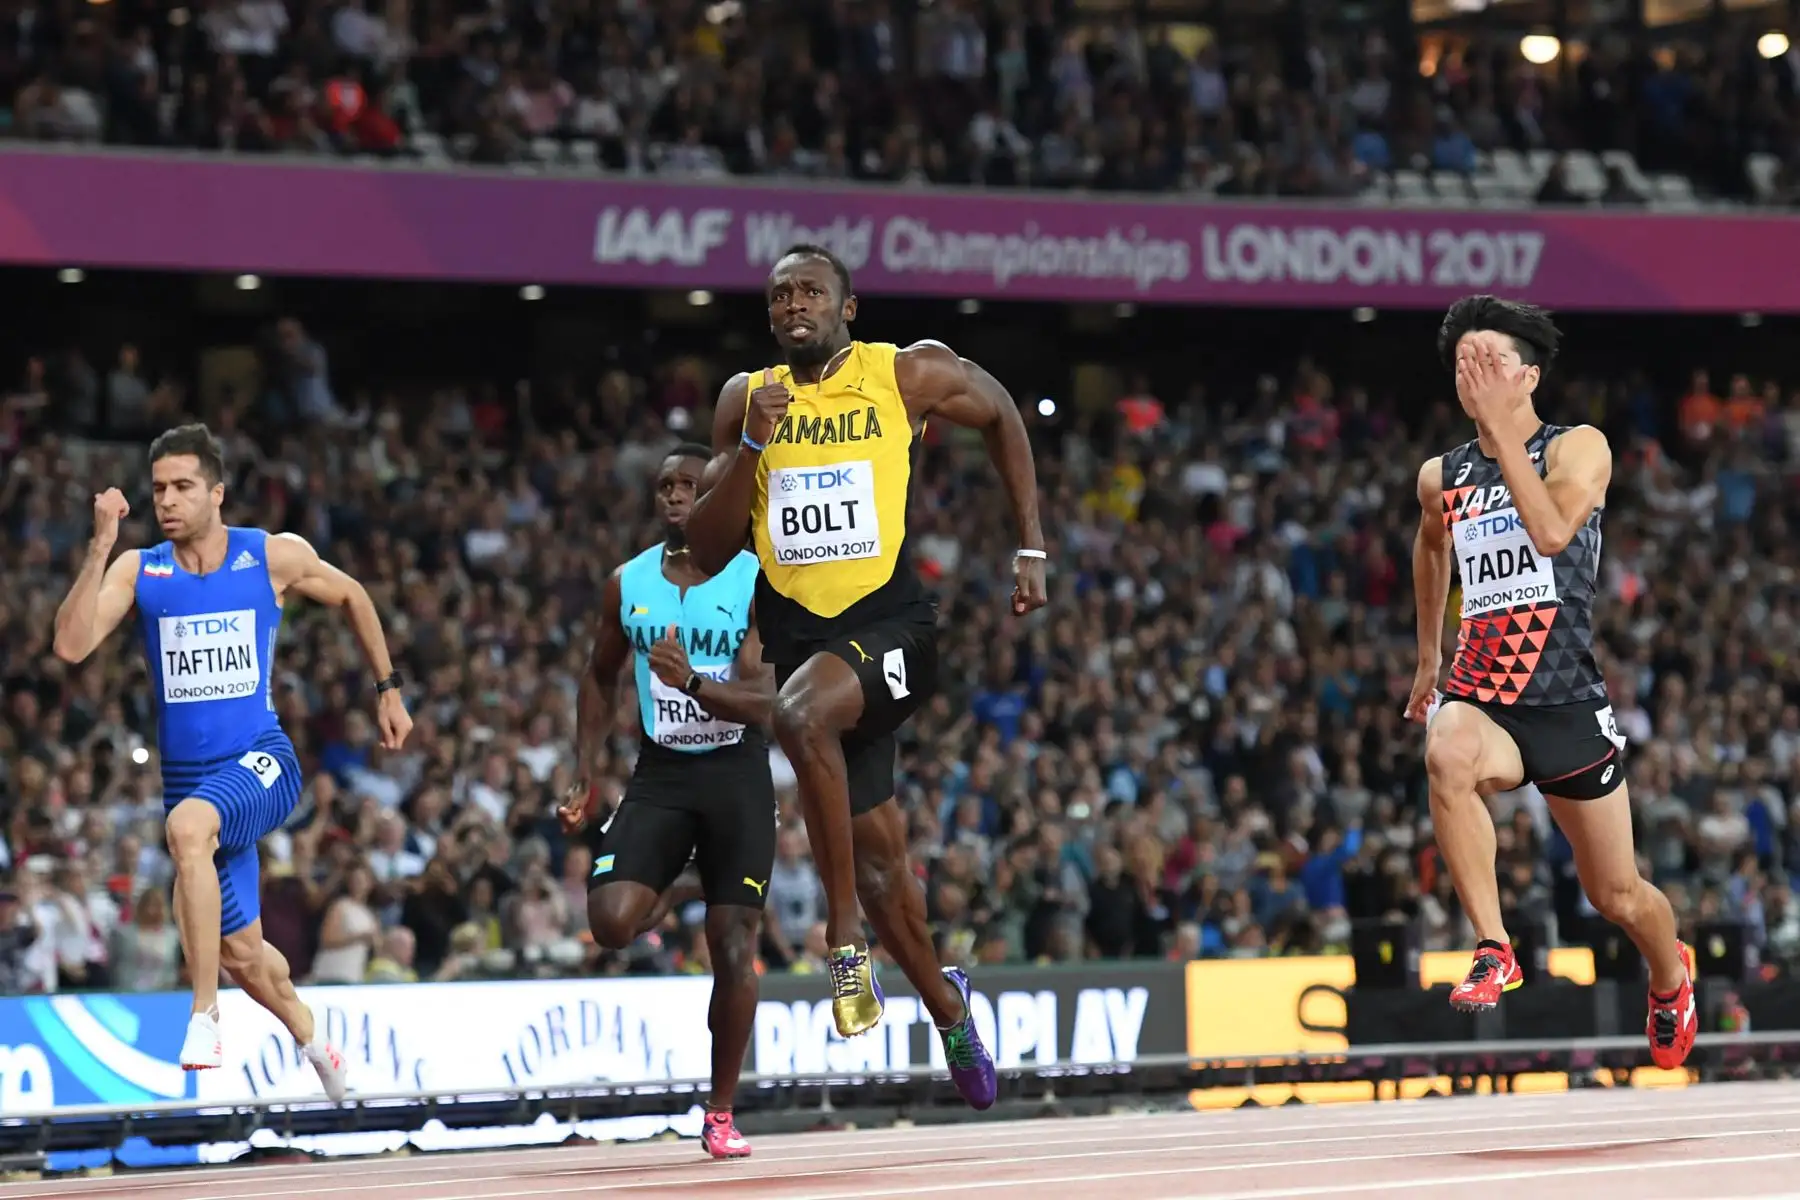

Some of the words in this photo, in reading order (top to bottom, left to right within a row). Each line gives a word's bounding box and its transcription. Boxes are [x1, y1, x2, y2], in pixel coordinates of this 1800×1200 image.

[596, 206, 733, 267] IAAF
[744, 211, 873, 271] World
[882, 216, 1190, 291] Championships
[1201, 224, 1424, 286] LONDON
[1427, 230, 1546, 287] 2017
[798, 468, 856, 490] TDK
[781, 500, 859, 537] BOLT
[1478, 513, 1526, 538] TDK
[778, 545, 839, 562] LONDON
[841, 540, 876, 556] 2017
[1465, 544, 1538, 586] TADA
[1465, 591, 1513, 613] LONDON
[1516, 584, 1549, 601] 2017
[187, 617, 241, 637] TDK
[166, 644, 252, 677] TAFTIAN
[168, 685, 225, 699] LONDON
[228, 680, 257, 694] 2017
[658, 732, 715, 745] LONDON
